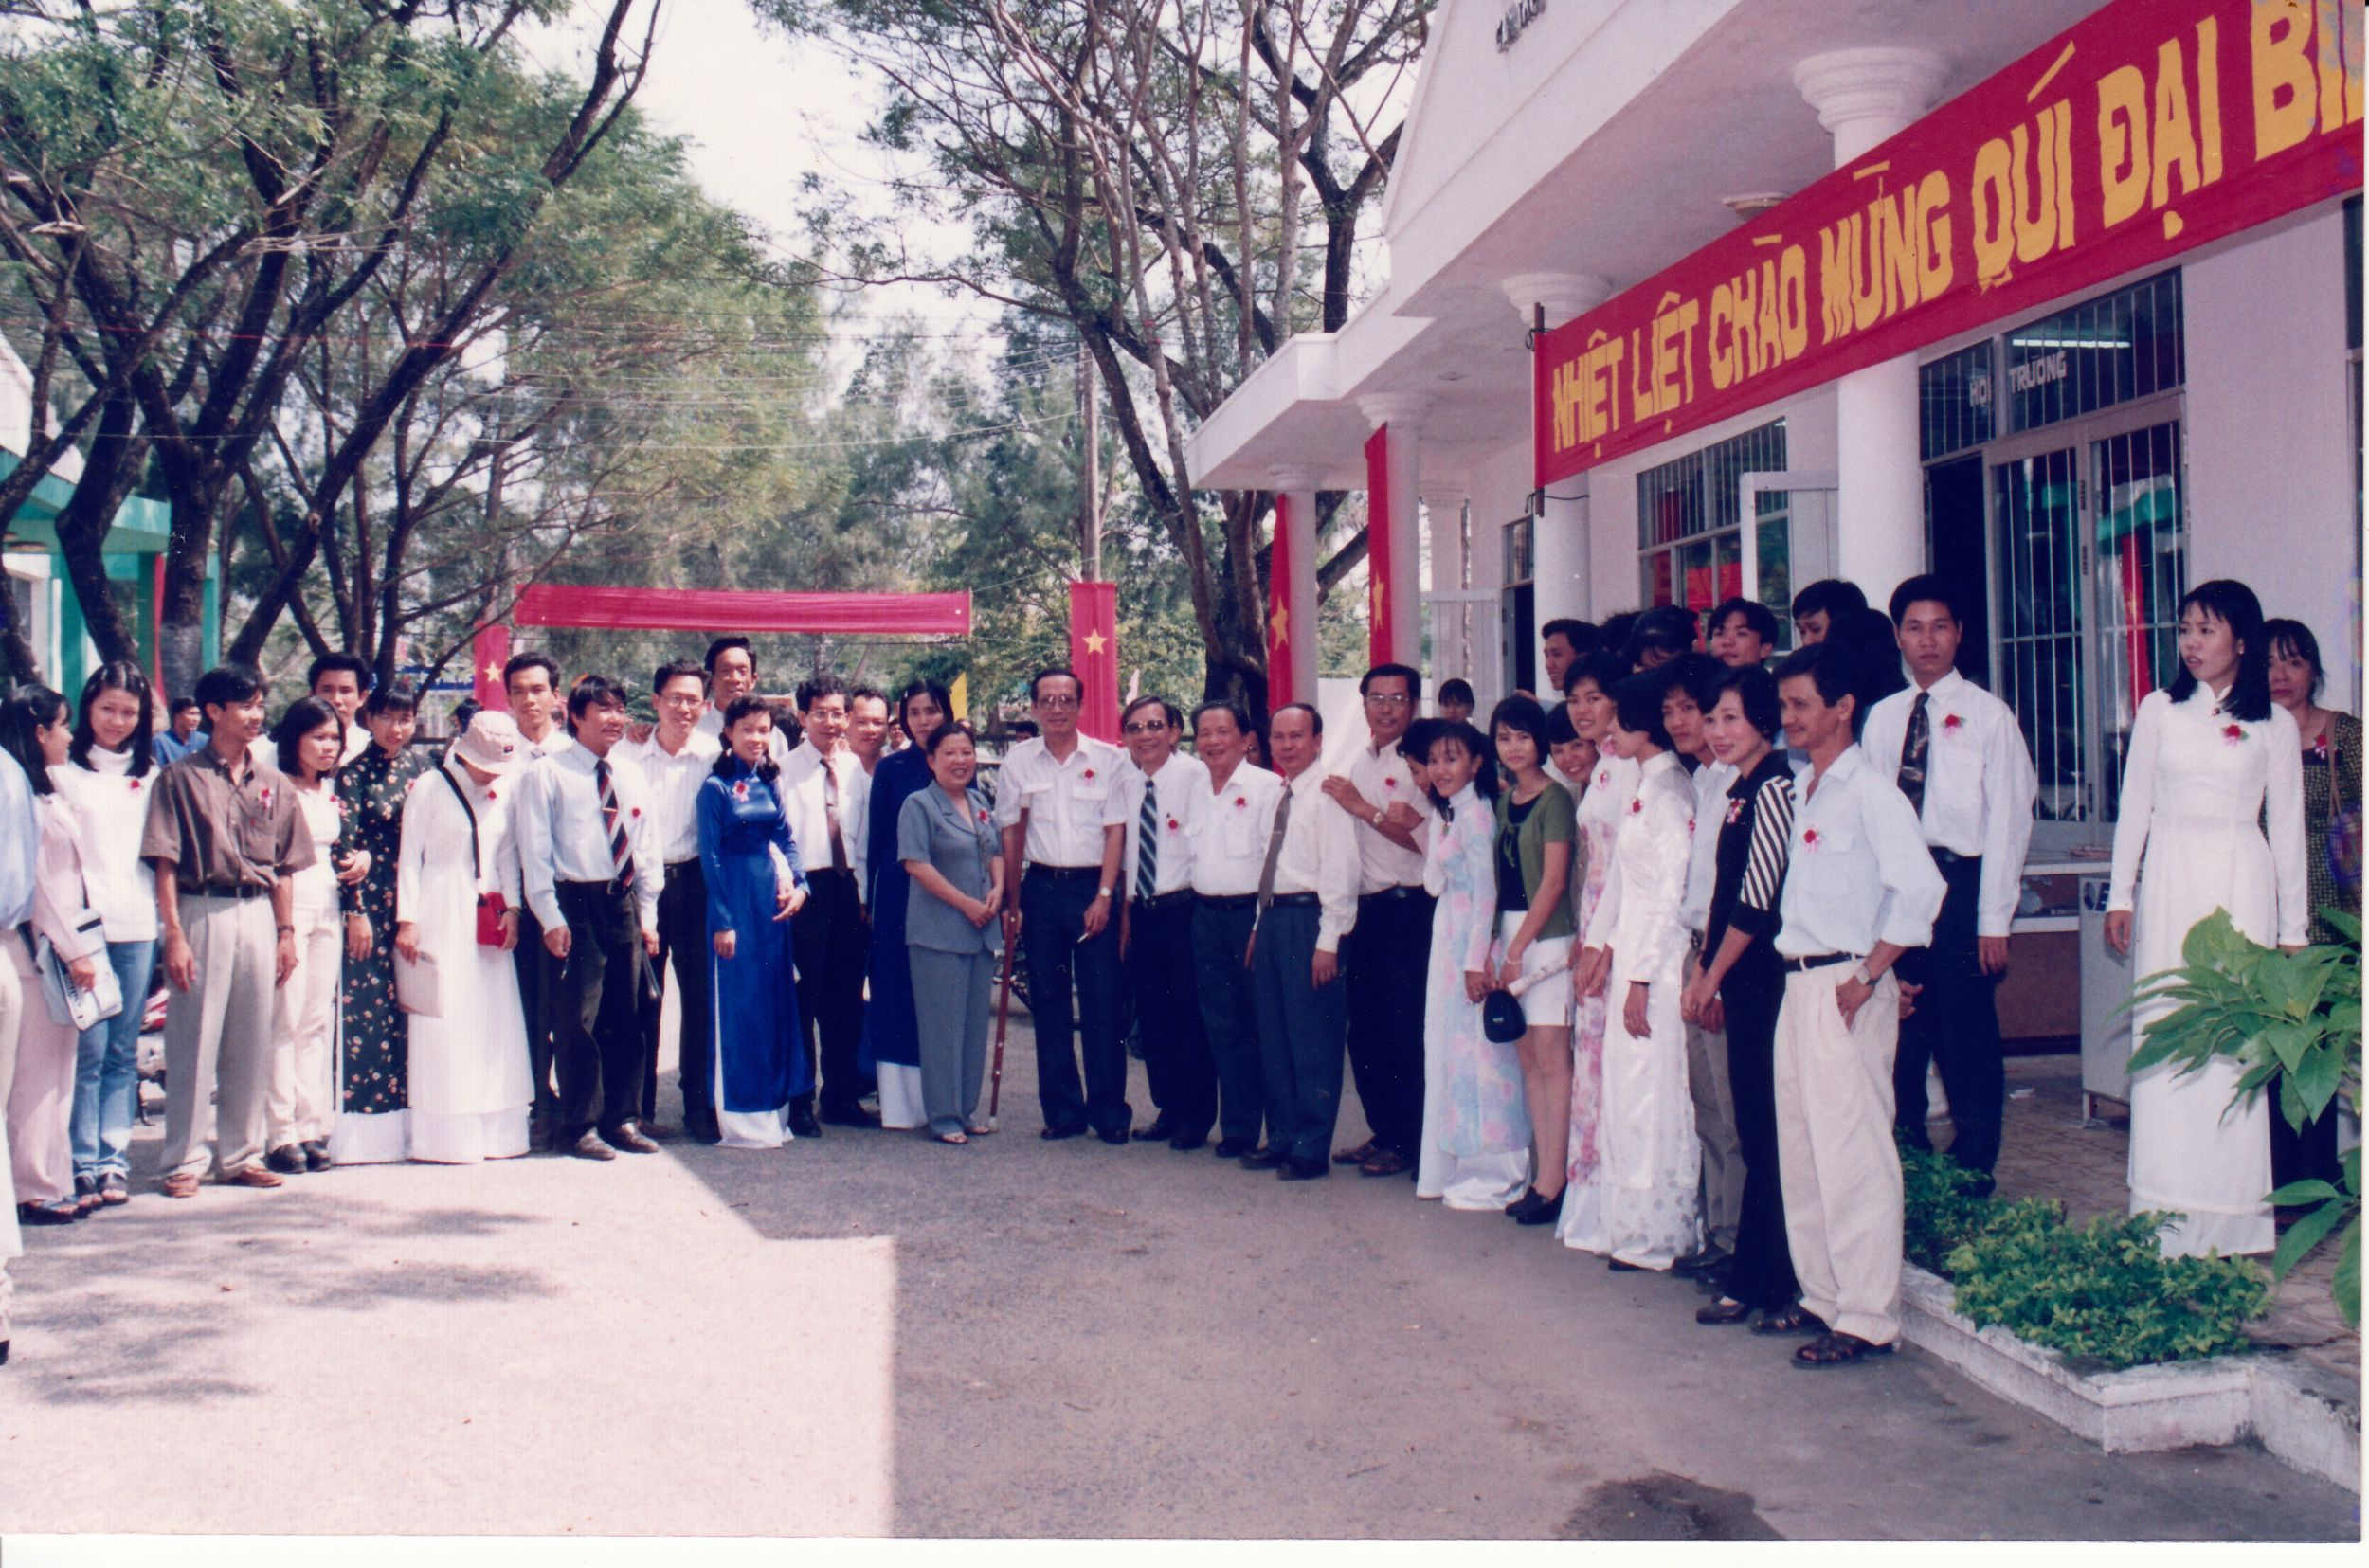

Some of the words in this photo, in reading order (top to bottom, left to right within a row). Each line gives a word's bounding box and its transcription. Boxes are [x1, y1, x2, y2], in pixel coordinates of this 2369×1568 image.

[1552, 328, 1624, 460] NHIỆT
[1632, 290, 1699, 435] LIỆT
[1709, 234, 1808, 390] CHÀO
[1818, 159, 1954, 346] MỪNG
[1971, 40, 2076, 296] QUÍ
[2097, 14, 2223, 240] ĐẠI
